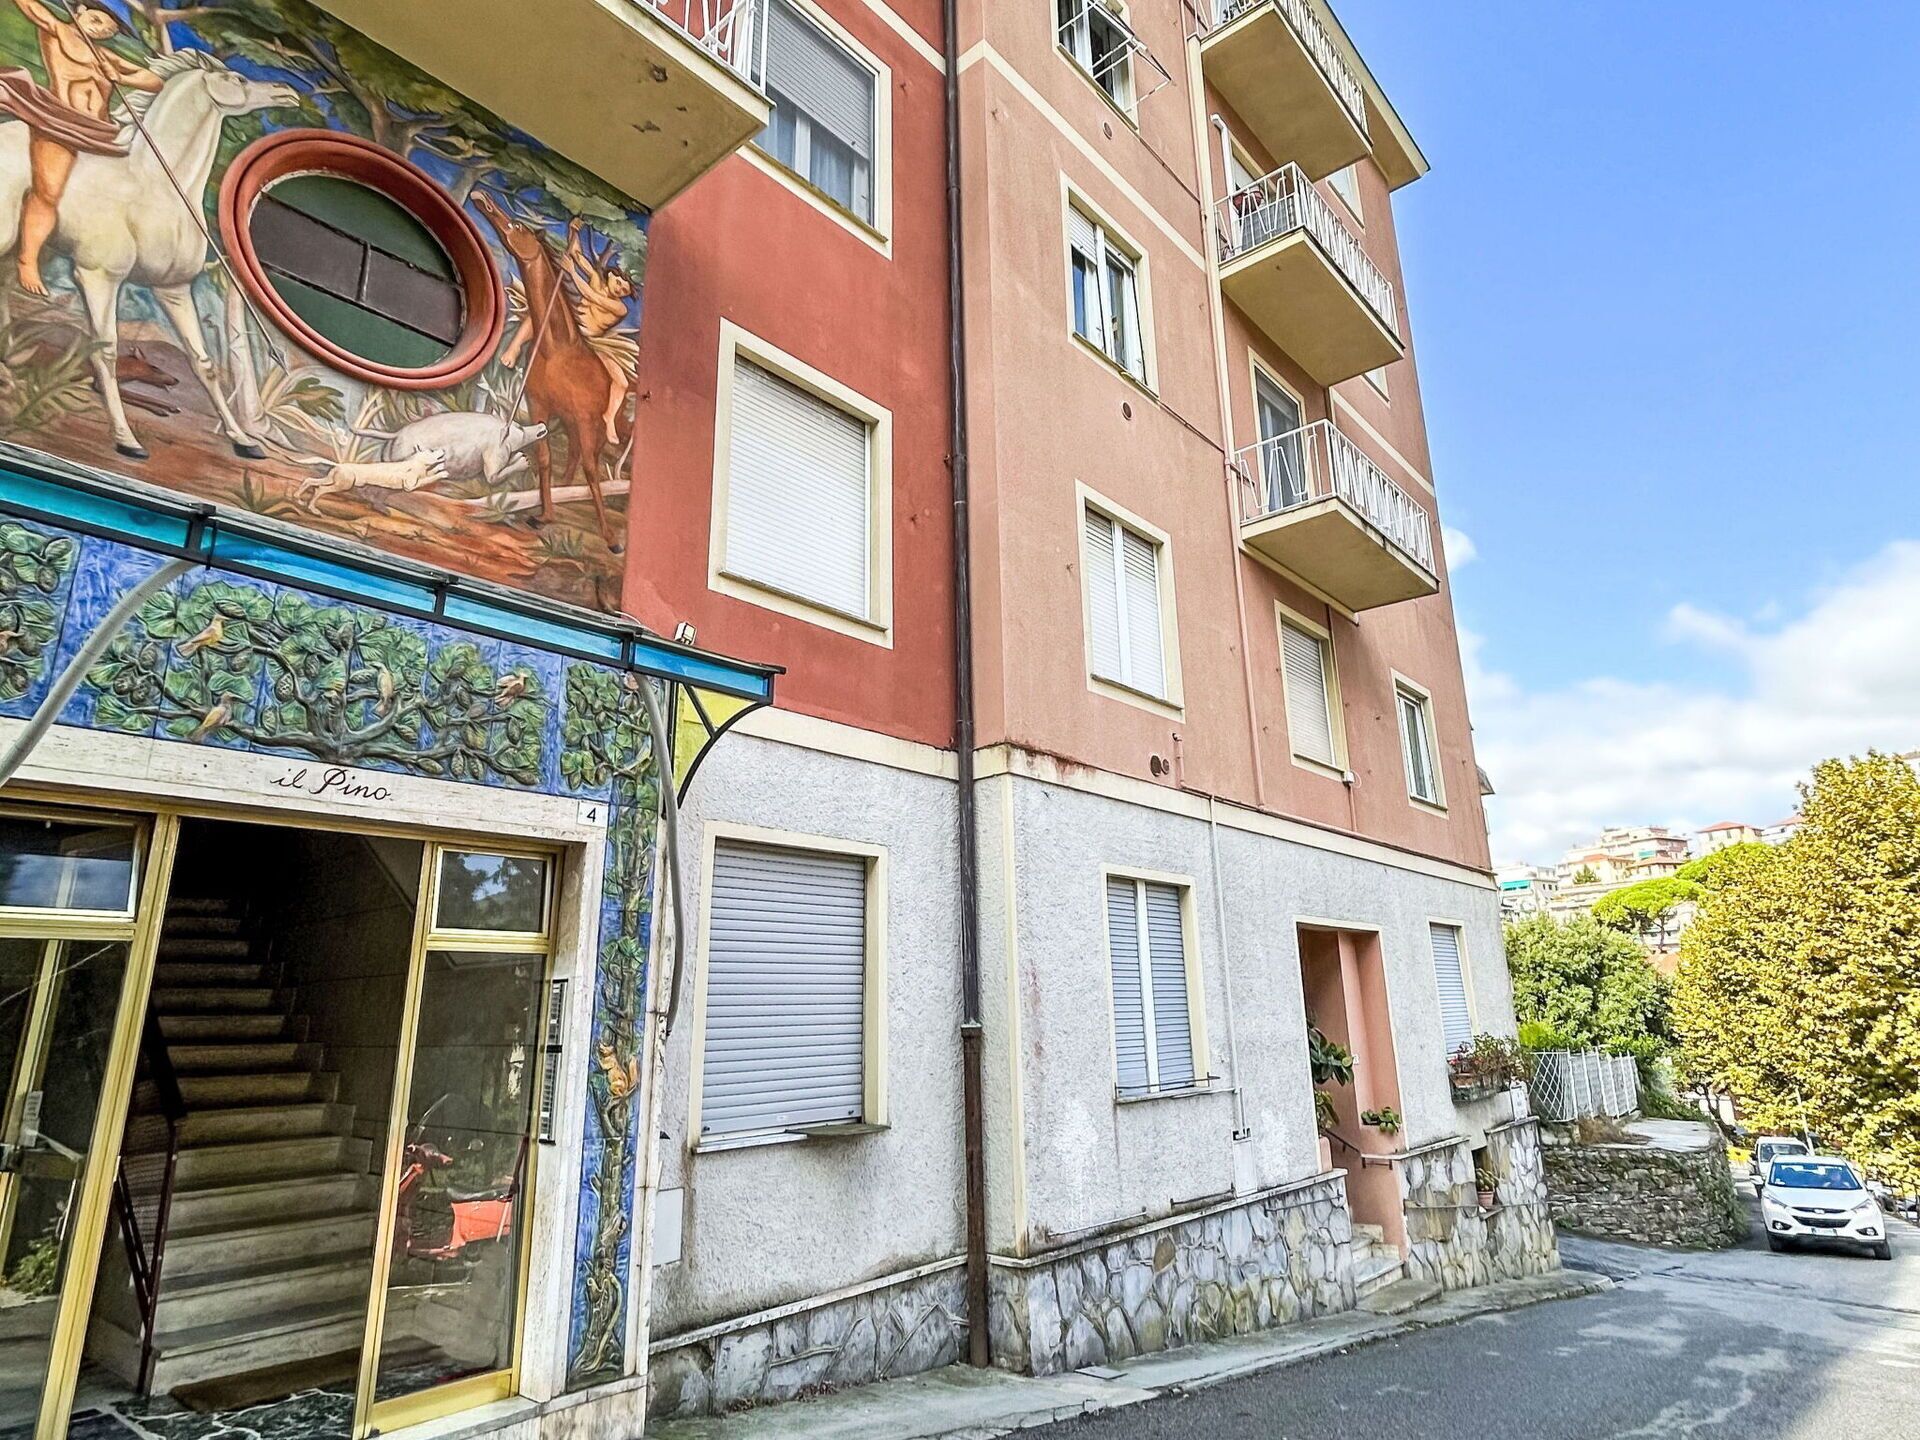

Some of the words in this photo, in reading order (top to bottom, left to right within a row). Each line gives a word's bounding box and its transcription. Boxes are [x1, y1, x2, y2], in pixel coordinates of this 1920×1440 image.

[270, 768, 303, 788] il
[308, 767, 391, 801] Pino
[586, 807, 597, 823] 4
